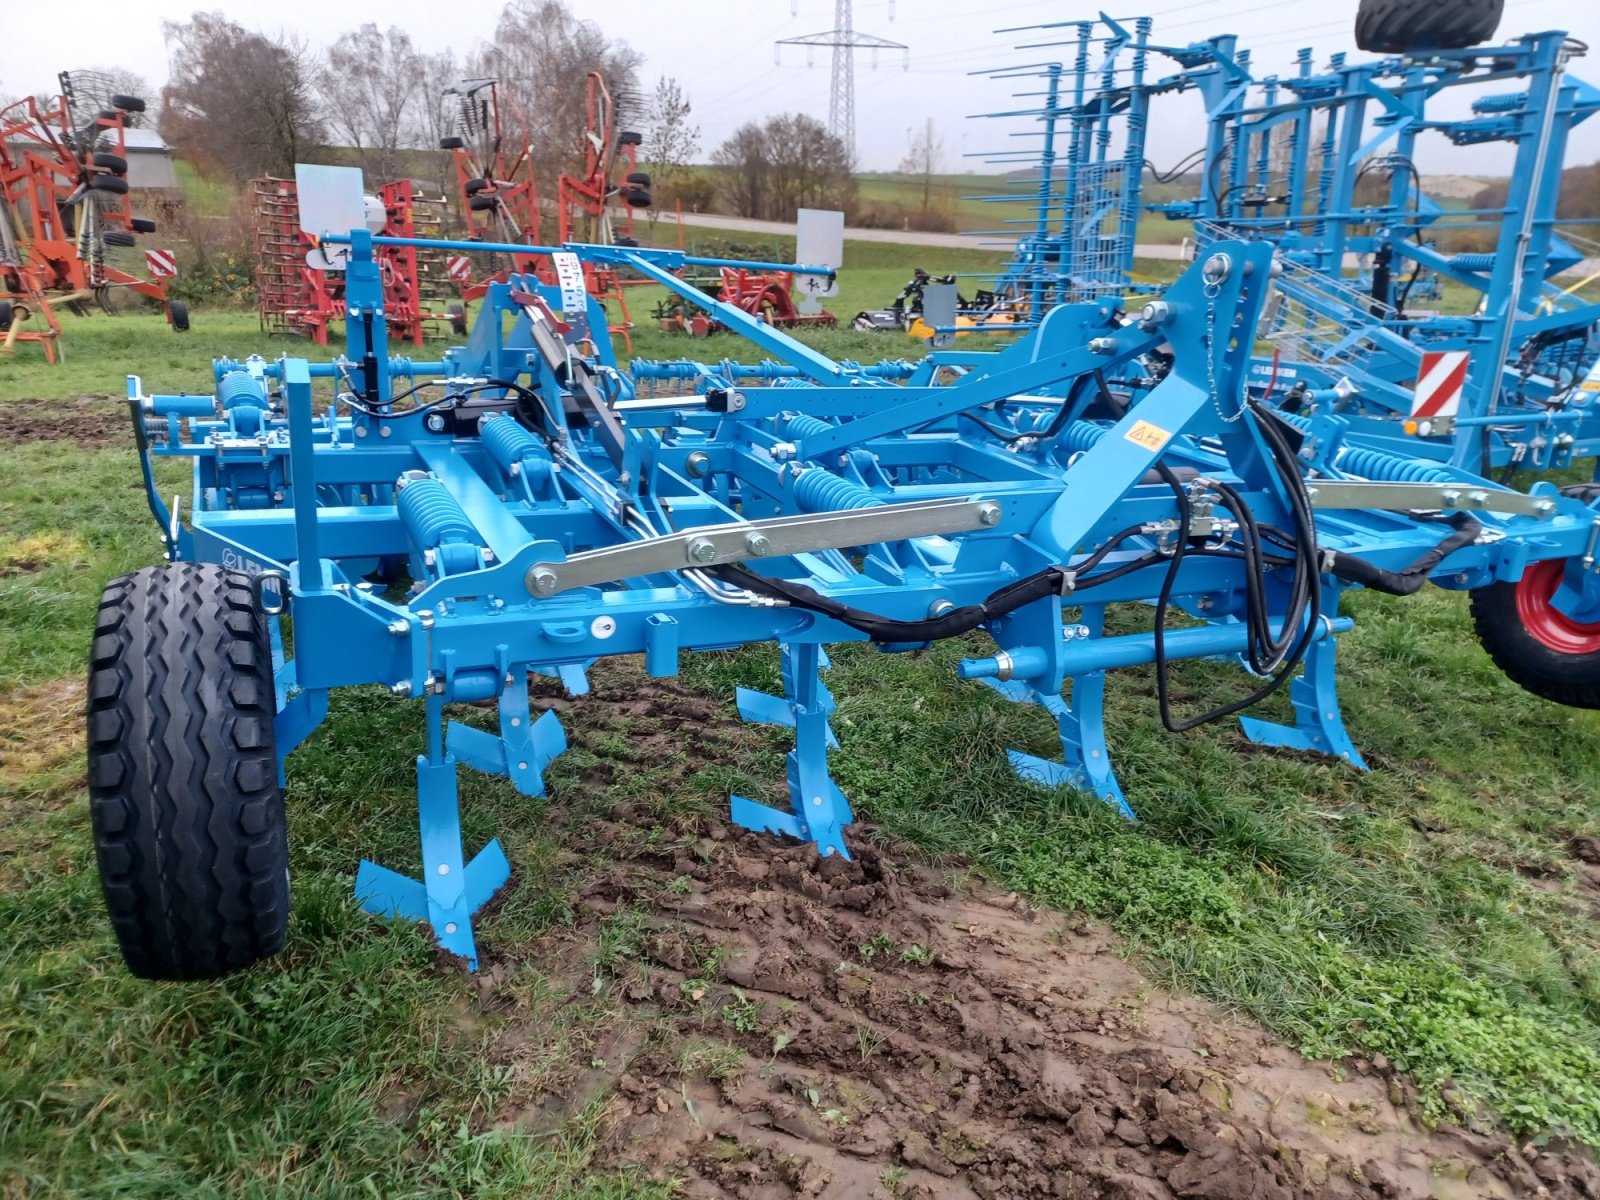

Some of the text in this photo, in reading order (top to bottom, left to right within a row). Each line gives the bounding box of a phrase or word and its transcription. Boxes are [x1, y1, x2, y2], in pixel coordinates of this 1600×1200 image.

[570, 261, 578, 270] 9
[573, 272, 580, 282] 7
[576, 285, 583, 297] 5
[578, 299, 585, 312] 3
[1260, 365, 1297, 379] LEKEN
